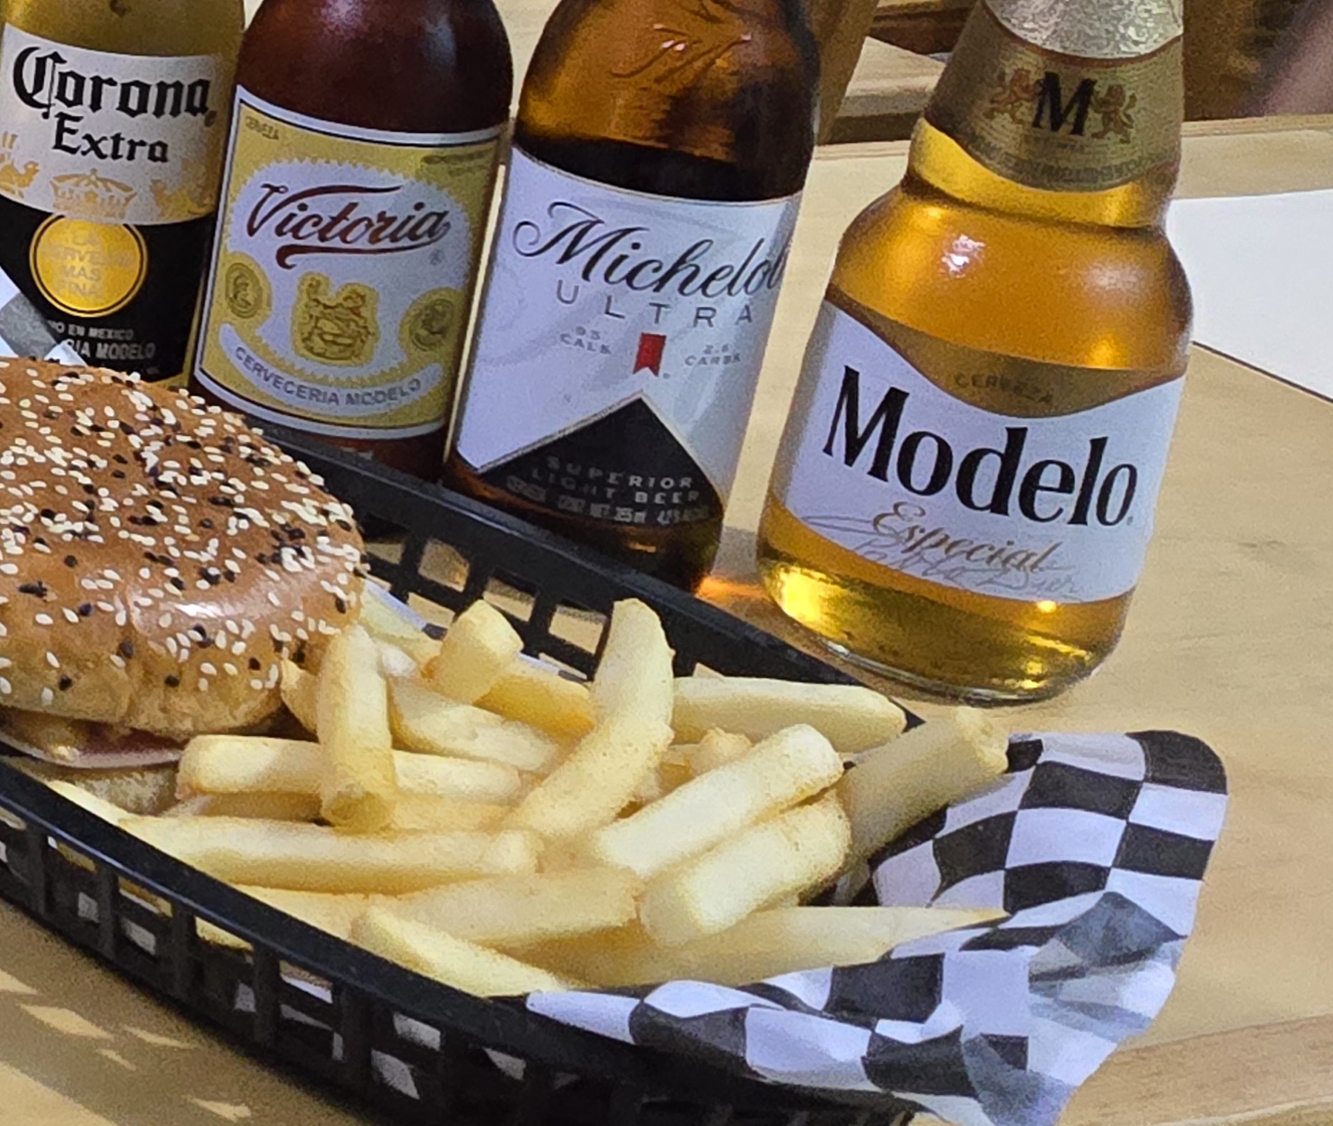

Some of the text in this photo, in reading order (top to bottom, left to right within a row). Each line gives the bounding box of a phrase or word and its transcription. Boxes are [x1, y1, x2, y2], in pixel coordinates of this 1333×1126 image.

[13, 46, 213, 119] Corona
[1031, 71, 1098, 136] M
[51, 111, 170, 163] Extra
[245, 182, 452, 264] Victoria
[557, 279, 753, 328] ULTRA
[96, 341, 156, 360] MODELO
[235, 346, 422, 406] CERVECERIA MODELO
[547, 455, 693, 490] SUPERIOR
[823, 365, 1137, 528] Modelo
[635, 490, 700, 504] BEER
[871, 501, 1064, 575] Especial
